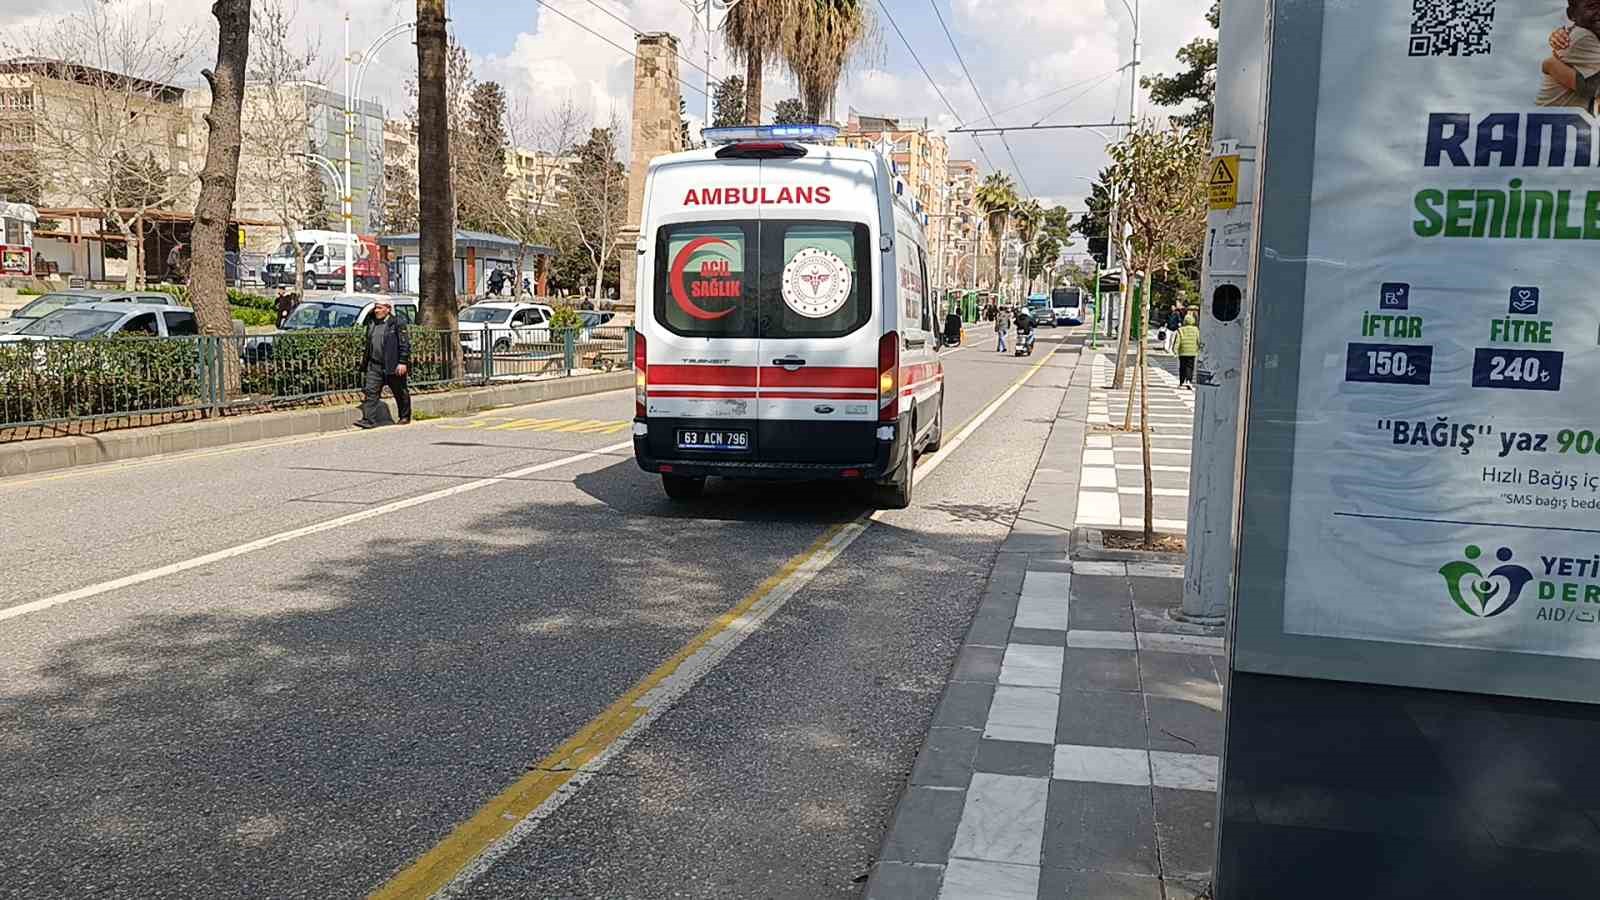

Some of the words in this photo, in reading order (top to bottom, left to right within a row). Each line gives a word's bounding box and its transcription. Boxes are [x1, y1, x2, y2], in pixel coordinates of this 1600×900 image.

[1220, 143, 1229, 154] 71
[1424, 113, 1600, 167] RAM
[683, 186, 831, 206] AMBULANS
[692, 279, 742, 297] SAĞLIK
[1362, 311, 1423, 338] İFTAR
[1490, 315, 1553, 343] FİTRE
[684, 432, 697, 444] 63
[703, 432, 722, 444] ACN
[727, 433, 746, 445] 796
[1498, 431, 1548, 457] yaz
[1483, 467, 1522, 484] Hızlı
[1528, 469, 1578, 490] Bağış
[1535, 497, 1567, 510] bağış
[1540, 554, 1600, 578] YETİ
[1539, 581, 1600, 604] DER
